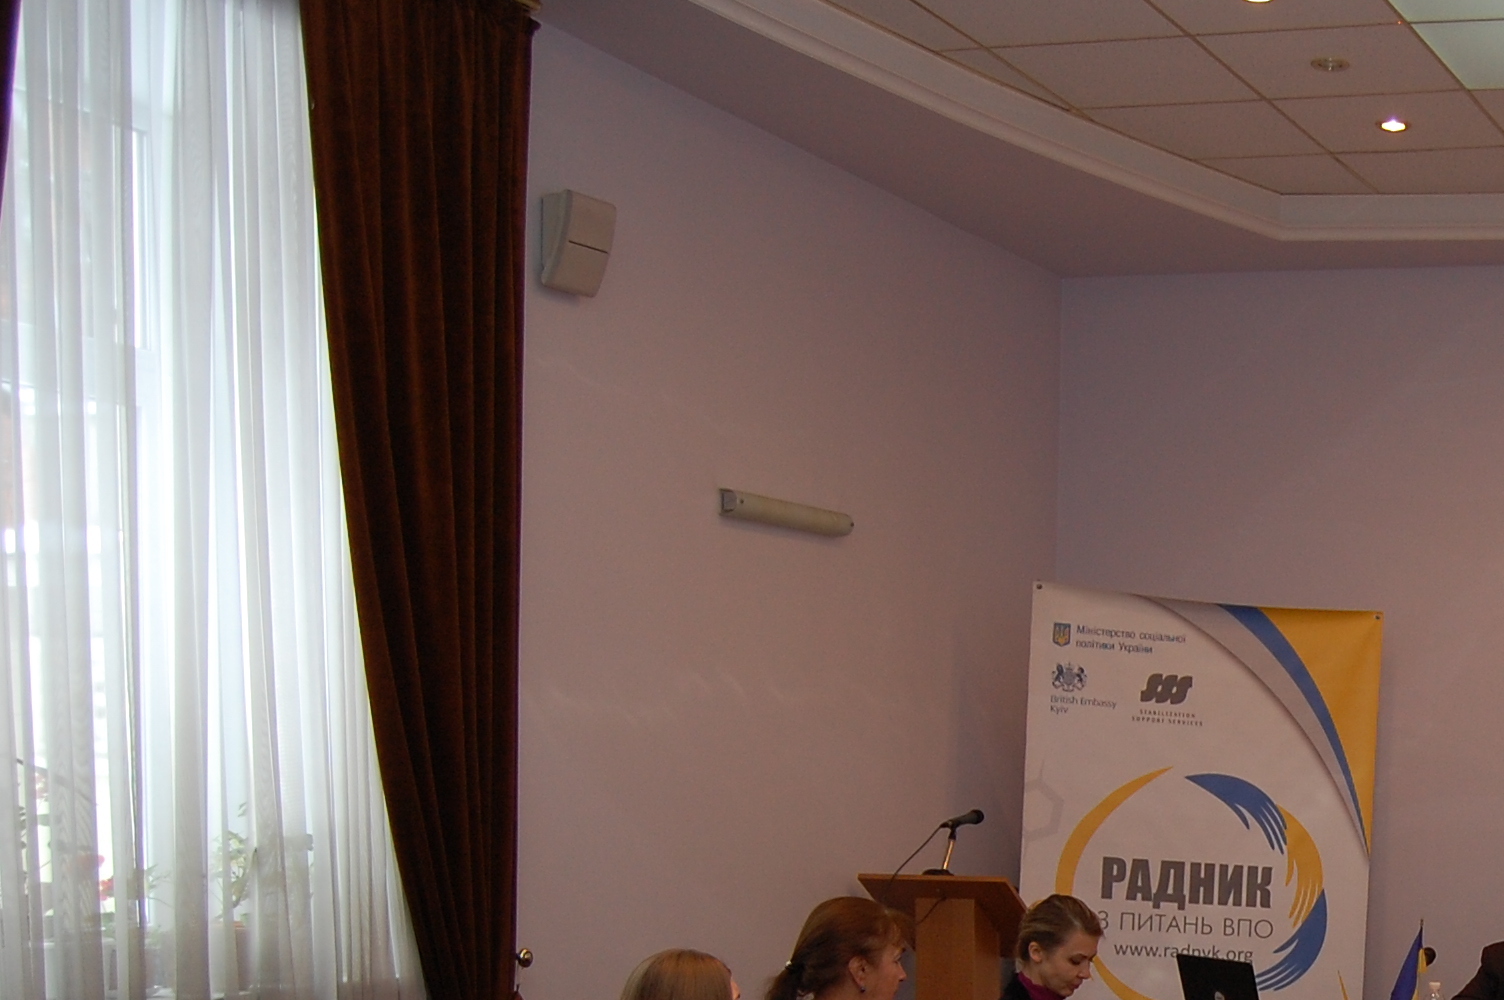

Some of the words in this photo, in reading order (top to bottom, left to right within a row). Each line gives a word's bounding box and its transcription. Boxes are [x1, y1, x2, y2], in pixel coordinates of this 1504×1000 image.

[1076, 624, 1136, 639] Міністерство
[1138, 631, 1186, 643] соціальної
[1075, 640, 1115, 651] політики
[1118, 642, 1153, 654] України
[1050, 695, 1079, 705] British
[1080, 696, 1117, 710] Embassy
[1050, 705, 1069, 714] Kyiv
[1131, 715, 1165, 724] SUPPORT
[1168, 718, 1203, 727] SERVICES
[1101, 856, 1273, 911] РАДНИК
[1120, 912, 1213, 935] ПИТАНЬ
[1223, 917, 1274, 939] ВПО
